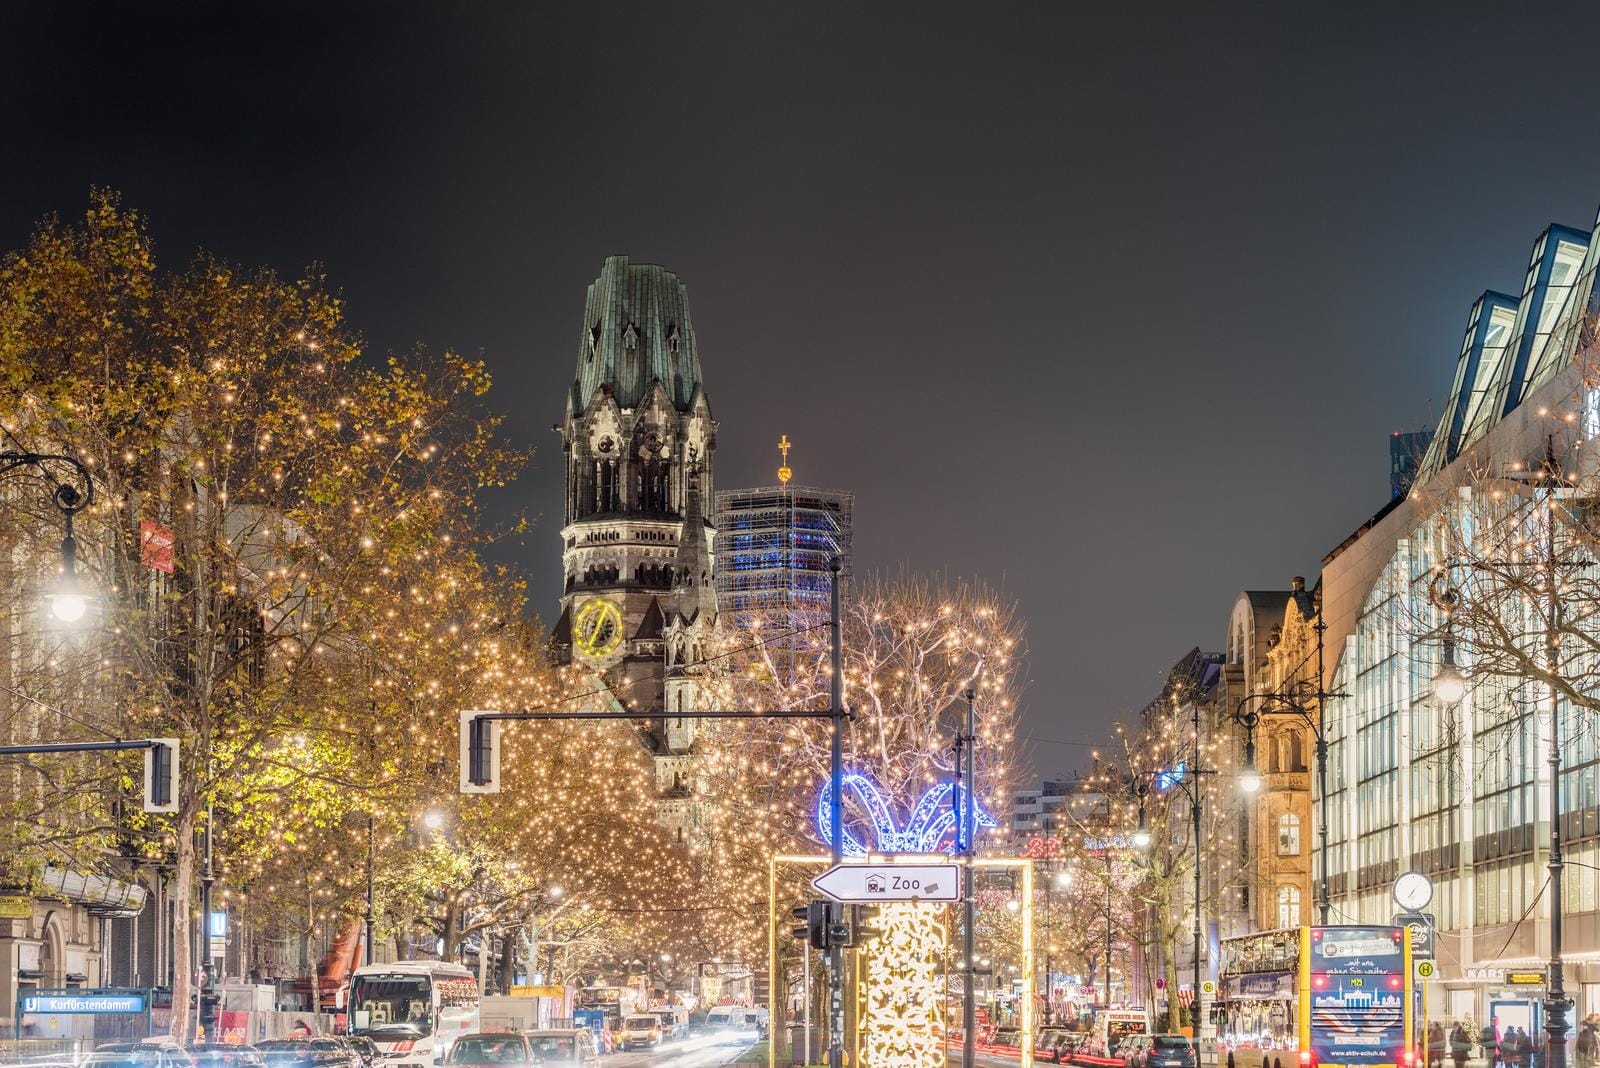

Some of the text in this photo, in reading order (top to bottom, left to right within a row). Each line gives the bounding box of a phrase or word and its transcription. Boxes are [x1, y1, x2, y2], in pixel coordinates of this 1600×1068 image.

[892, 876, 920, 890] Zoo
[213, 915, 225, 936] U
[1467, 967, 1505, 979] KARS
[25, 997, 131, 1012] U Kurfürstendamm
[1330, 1049, 1387, 1057] www.aktiv-schuh.de
